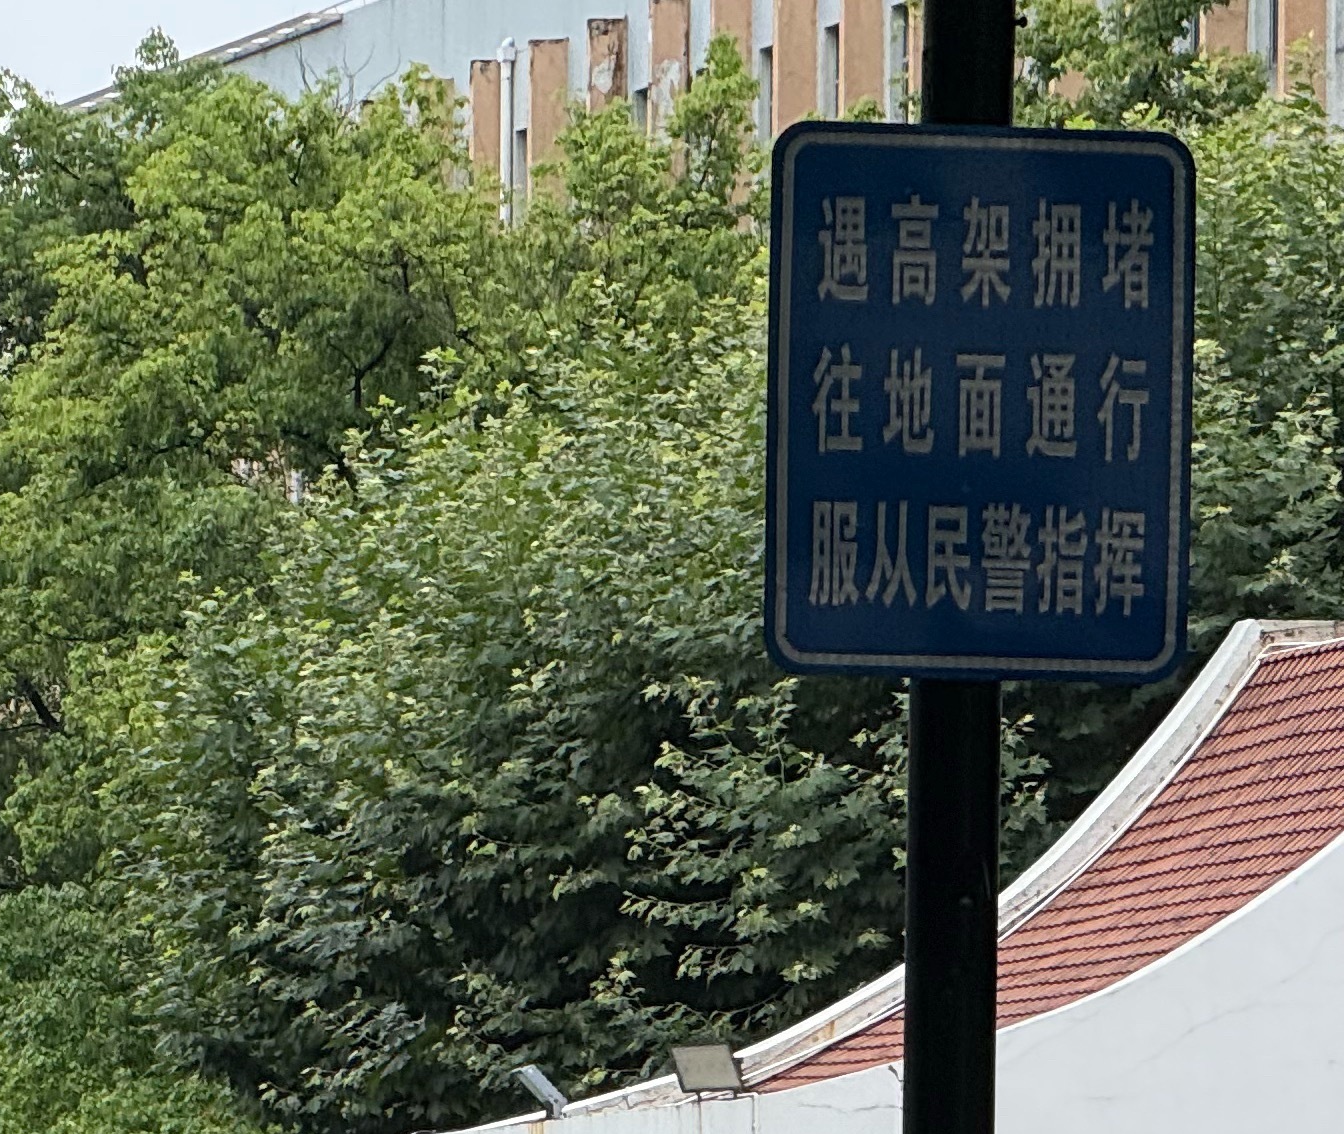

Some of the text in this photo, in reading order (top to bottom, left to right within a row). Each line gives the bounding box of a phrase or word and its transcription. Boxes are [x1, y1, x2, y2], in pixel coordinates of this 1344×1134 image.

[818, 194, 1155, 309] 遇高架拥堵
[811, 342, 1150, 462] 往地面通行
[809, 500, 1148, 618] 服从民警指挥
